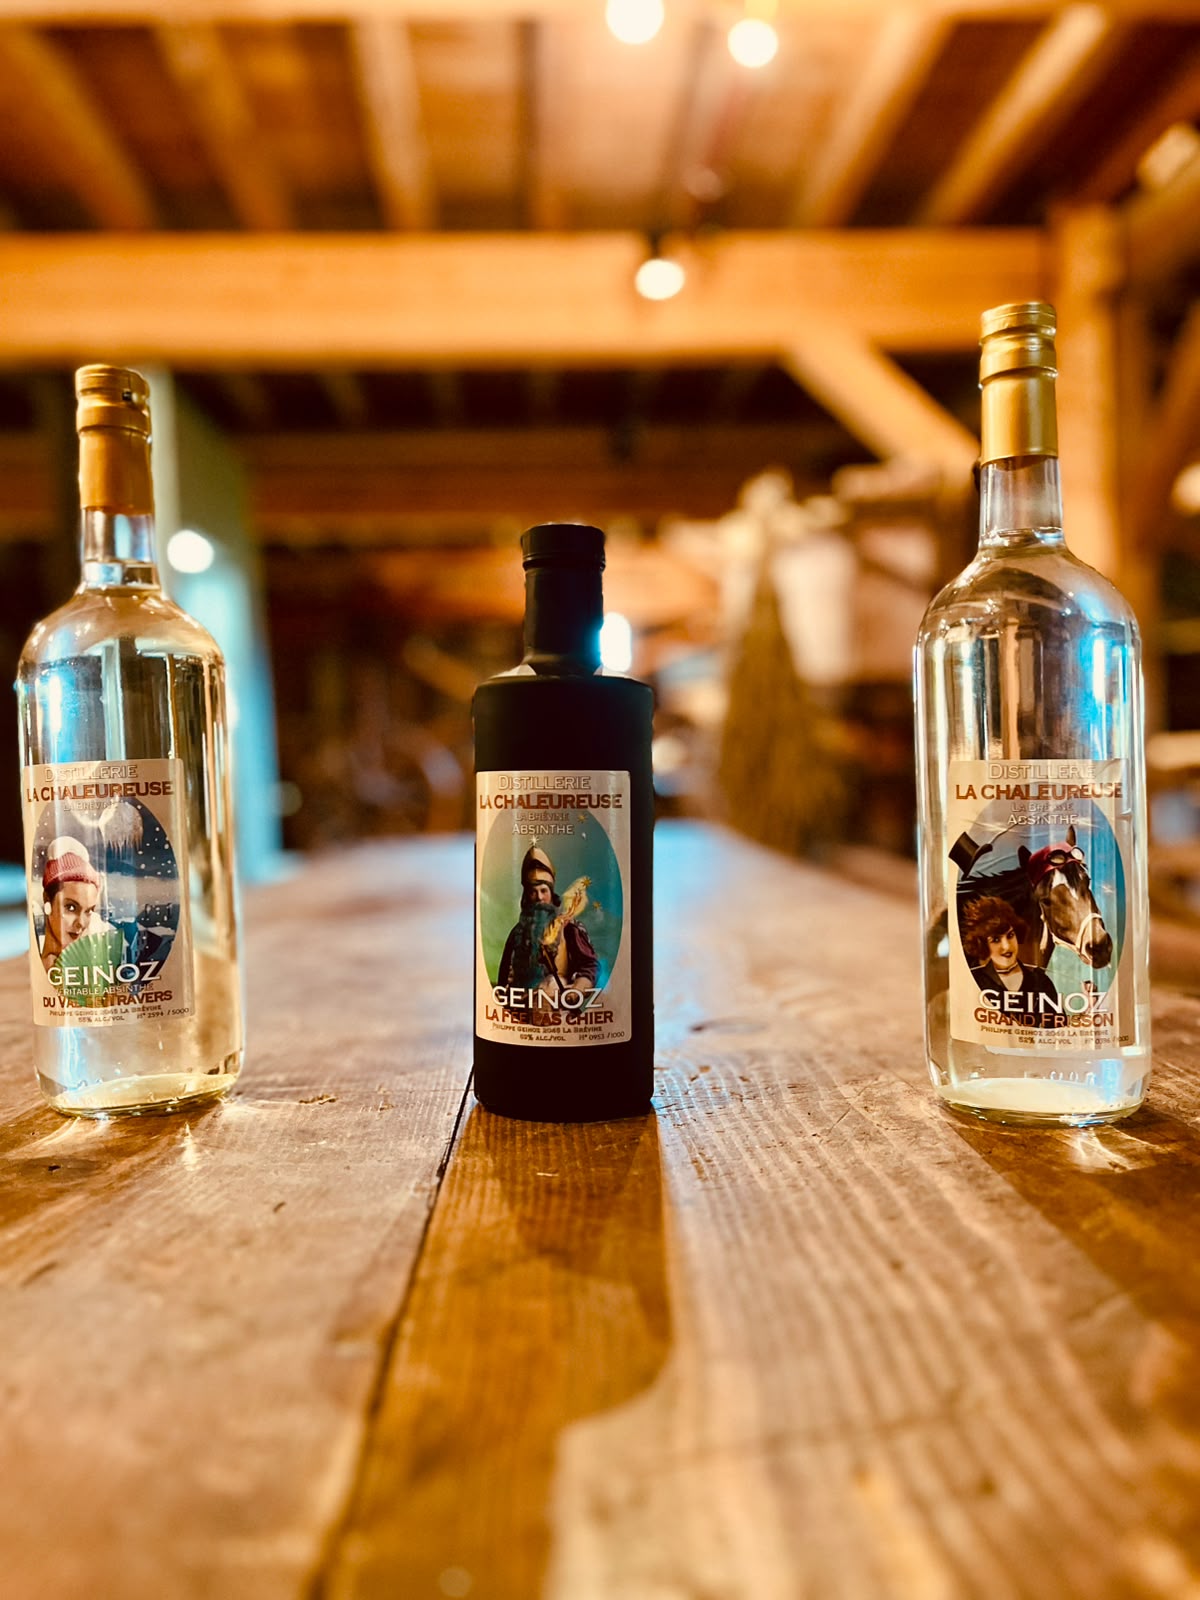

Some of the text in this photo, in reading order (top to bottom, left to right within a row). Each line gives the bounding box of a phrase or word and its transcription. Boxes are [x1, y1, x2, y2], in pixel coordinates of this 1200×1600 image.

[45, 765, 138, 782] DISTILLERIE
[989, 763, 1095, 780] DISTILLERIE
[498, 775, 591, 790] DISTILLERIE
[26, 781, 174, 802] LA CHALEUREUSE
[955, 782, 1122, 801] LA CHALEUREUSE
[480, 793, 622, 809] LA CHALEUREUSE
[1011, 802, 1026, 813] LA
[515, 812, 526, 821] LA
[1007, 813, 1079, 825] ABSINTHE
[512, 823, 574, 835] ABSINTHE
[47, 961, 161, 986] GEINOZ
[101, 982, 154, 995] ABSINTHE
[492, 985, 604, 1009] GEINOZ
[43, 996, 56, 1007] DU
[107, 990, 173, 1007] TRAVERS
[978, 988, 1109, 1013] GEINOZ
[485, 1005, 499, 1021] LA
[532, 1009, 562, 1026] PAS
[565, 1010, 614, 1026] CHIER
[974, 1008, 1114, 1028] GRAND FRISSON
